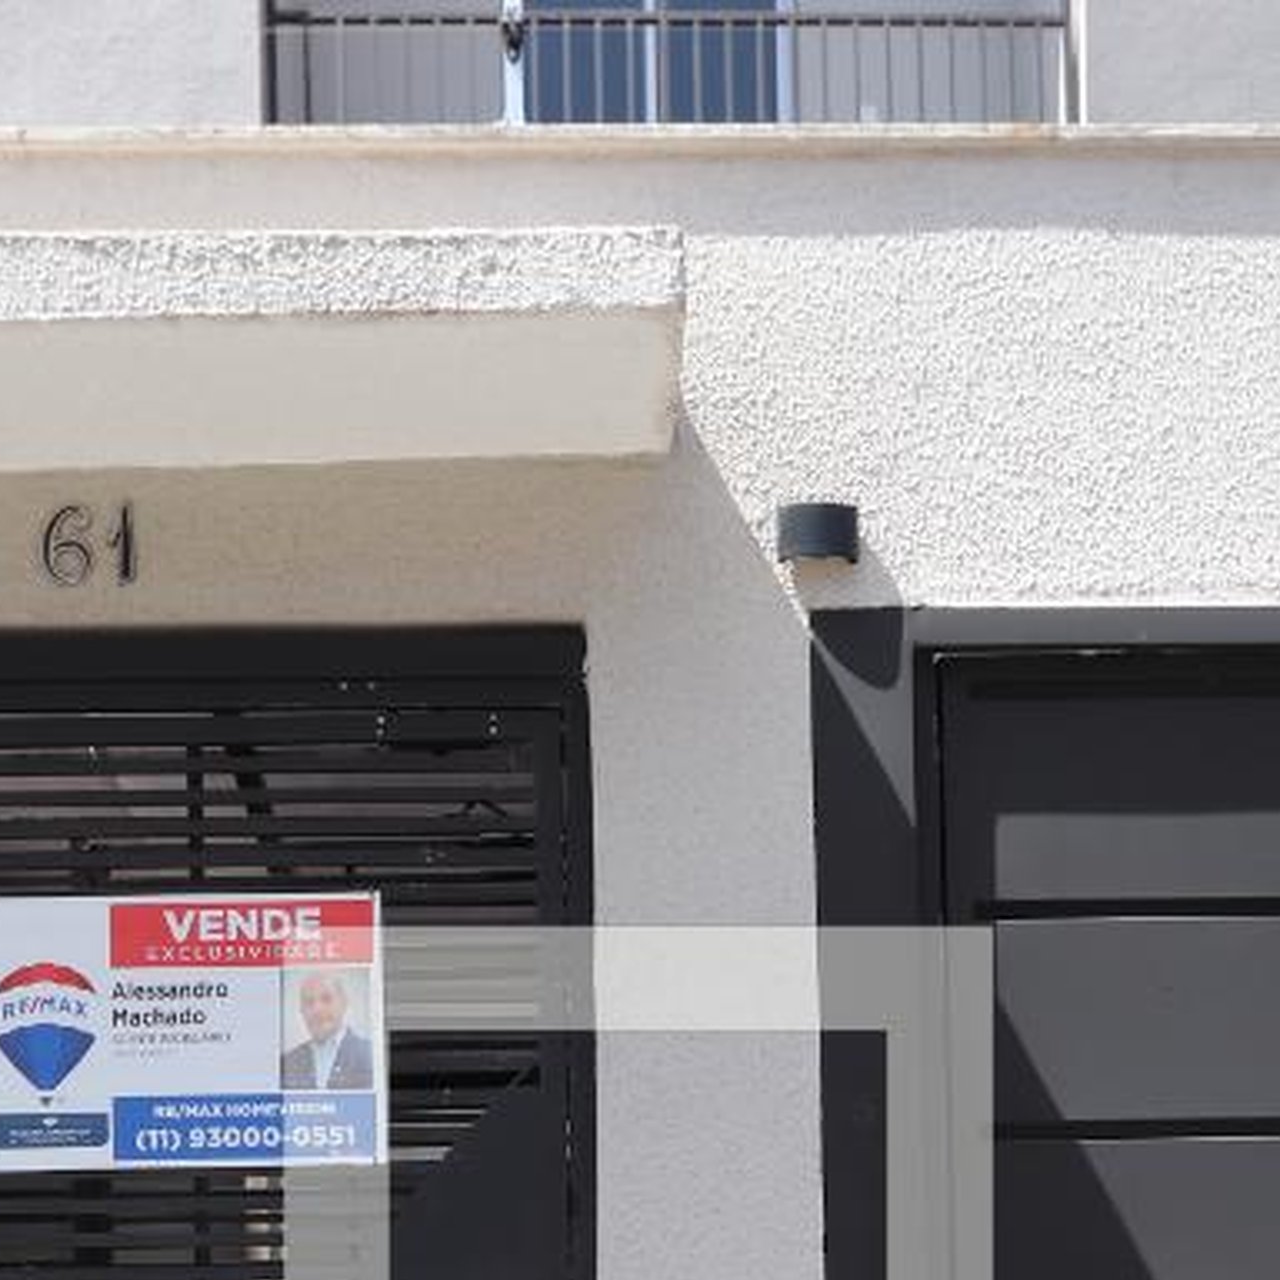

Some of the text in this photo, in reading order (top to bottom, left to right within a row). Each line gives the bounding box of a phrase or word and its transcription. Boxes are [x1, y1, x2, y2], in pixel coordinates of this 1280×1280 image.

[42, 501, 137, 588] 61
[163, 905, 321, 943] VENDE
[112, 981, 229, 1000] Alessandro
[2, 995, 88, 1020] RE/MAX
[112, 1008, 207, 1027] Machado
[136, 1124, 356, 1151] (11) 93000-0551
